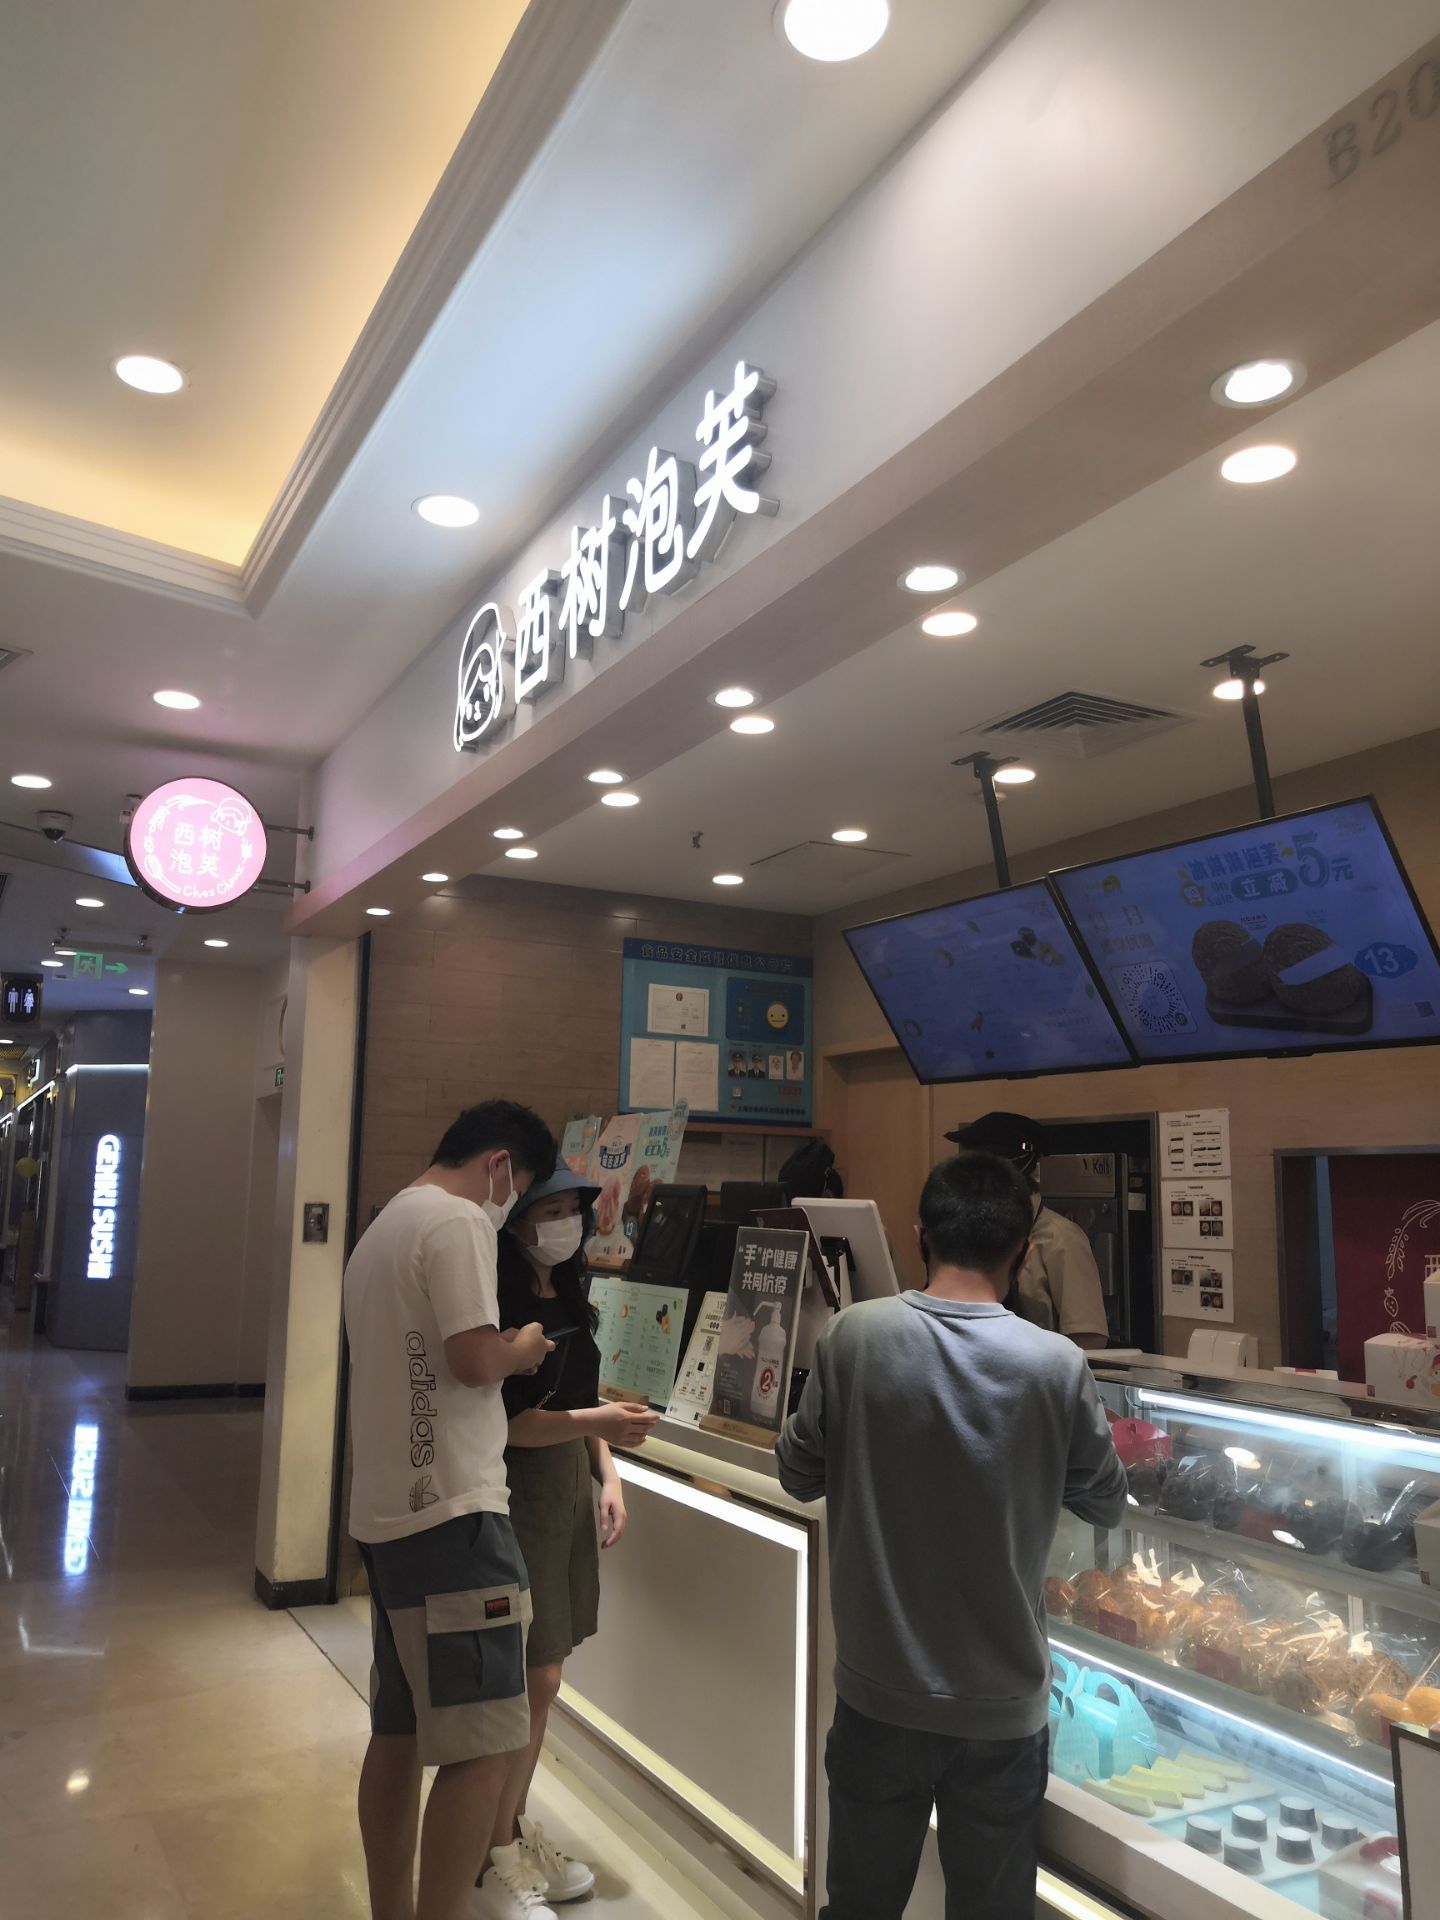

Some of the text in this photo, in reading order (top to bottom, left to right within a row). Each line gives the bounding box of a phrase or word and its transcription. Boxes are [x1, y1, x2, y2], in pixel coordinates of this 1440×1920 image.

[514, 360, 761, 704] 西树泡芙
[173, 821, 224, 850] 西树
[169, 848, 220, 879] 泡芙
[1239, 869, 1290, 899] 立减
[1365, 947, 1400, 975] 13
[87, 1134, 120, 1279] GENKI SUSHI
[741, 1270, 788, 1295] 共同抗疫
[405, 1331, 437, 1468] adidas
